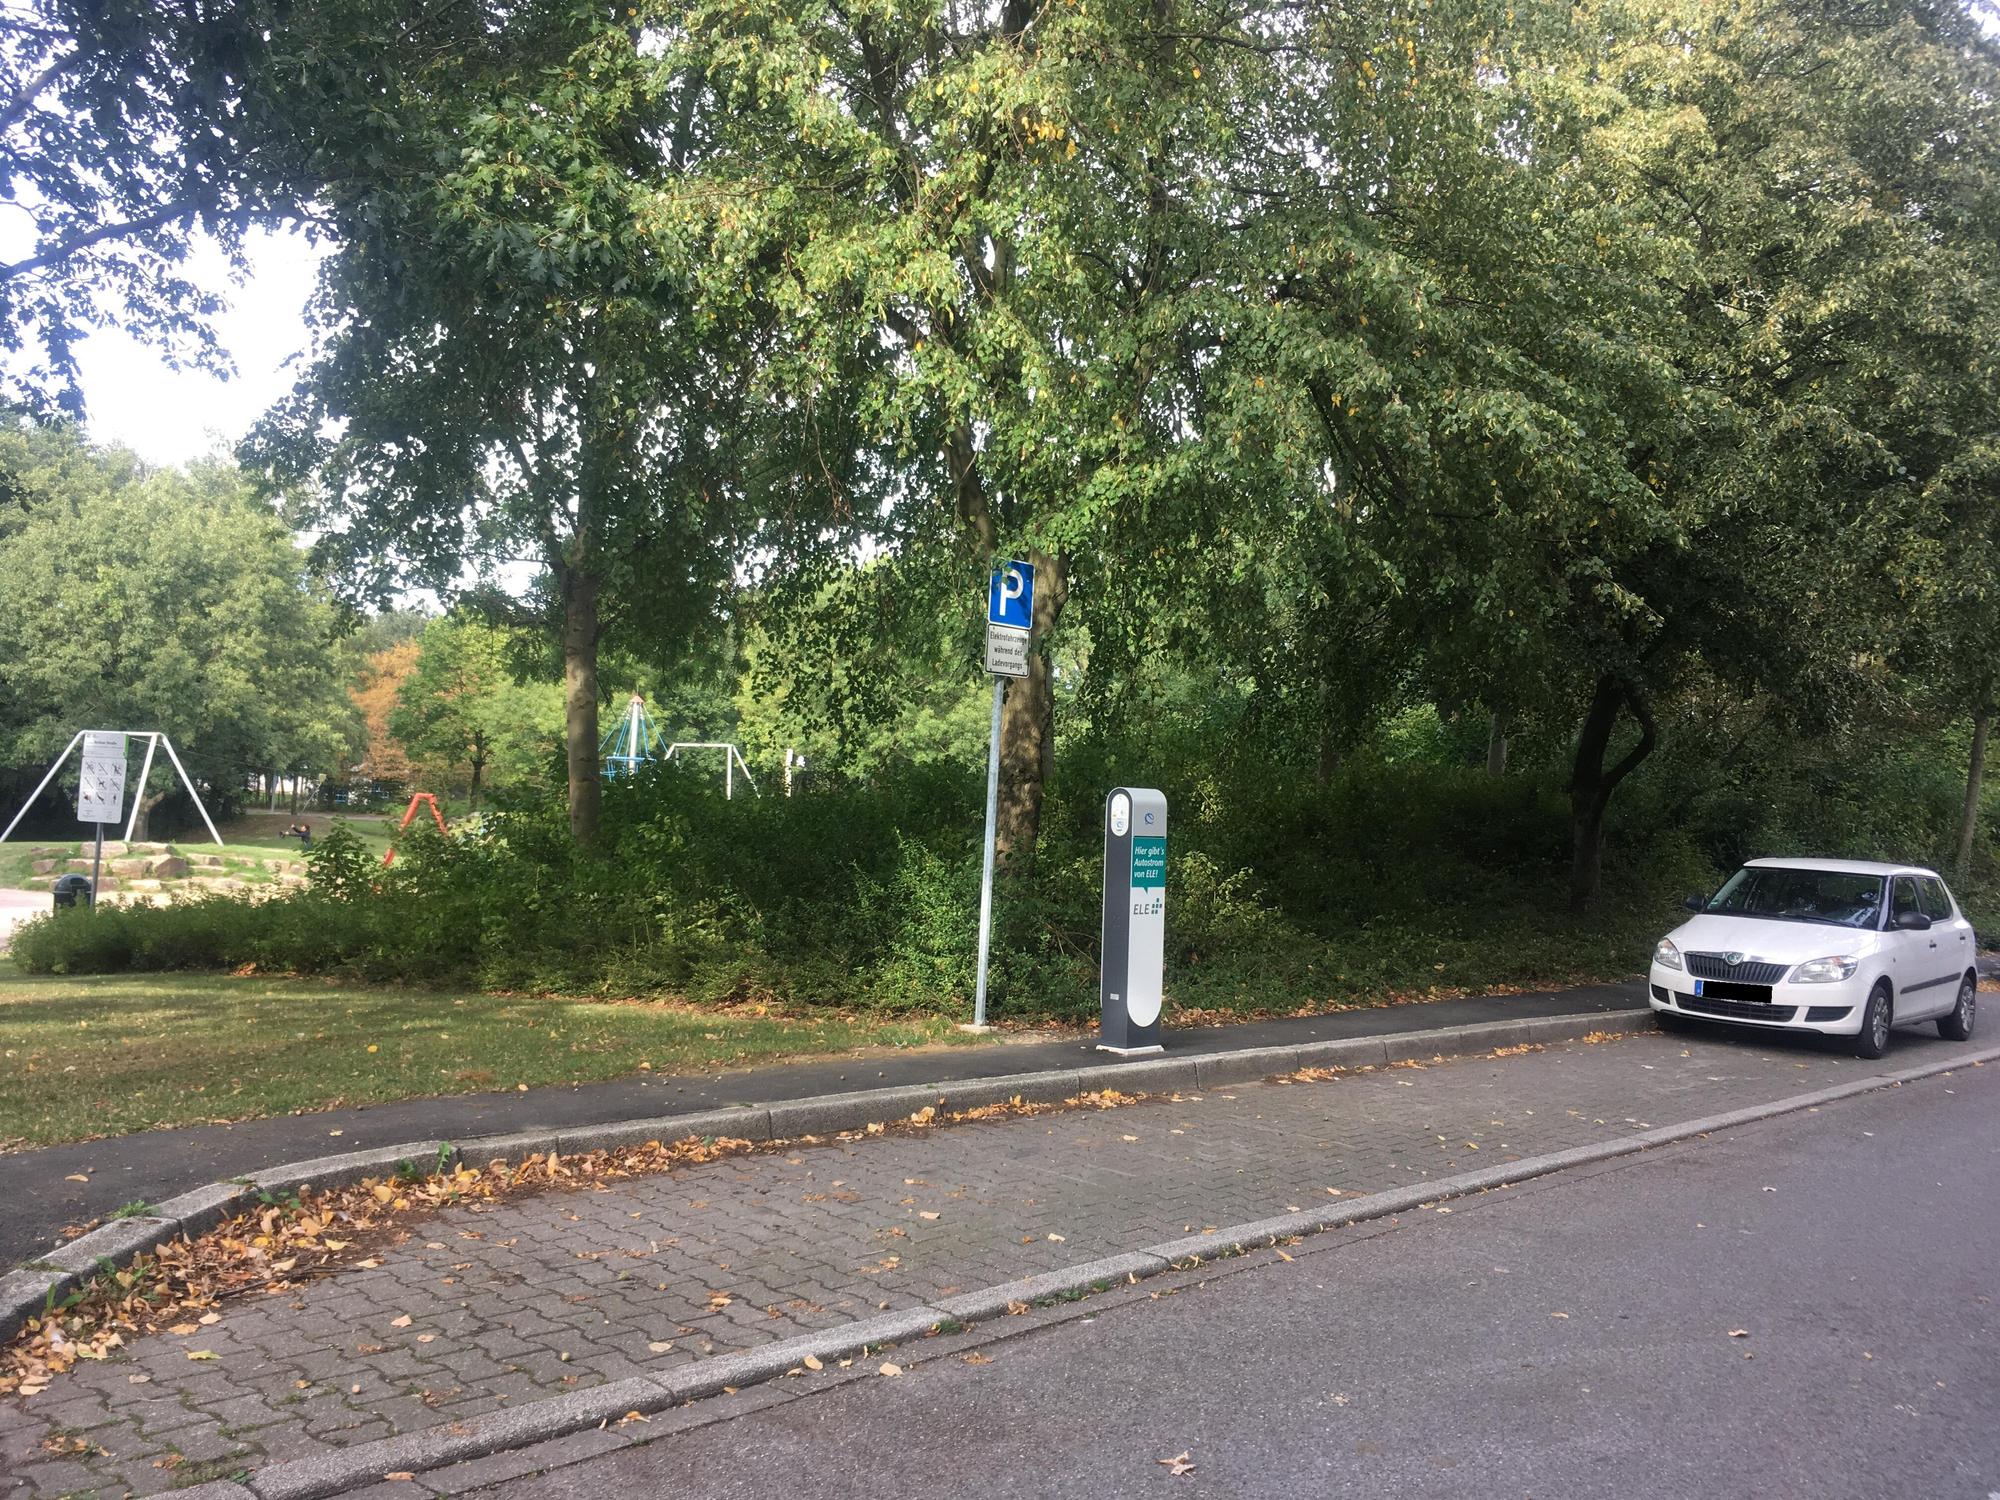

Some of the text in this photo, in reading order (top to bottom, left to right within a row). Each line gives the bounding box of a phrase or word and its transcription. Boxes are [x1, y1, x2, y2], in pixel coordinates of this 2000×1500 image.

[1000, 569, 1023, 616] P
[994, 646, 1013, 655] während
[992, 658, 1023, 670] Ladevorgangs
[1135, 847, 1147, 855] Hier
[1134, 858, 1164, 867] Autostrom
[1146, 870, 1158, 878] ELE!
[1133, 903, 1150, 915] ELE
